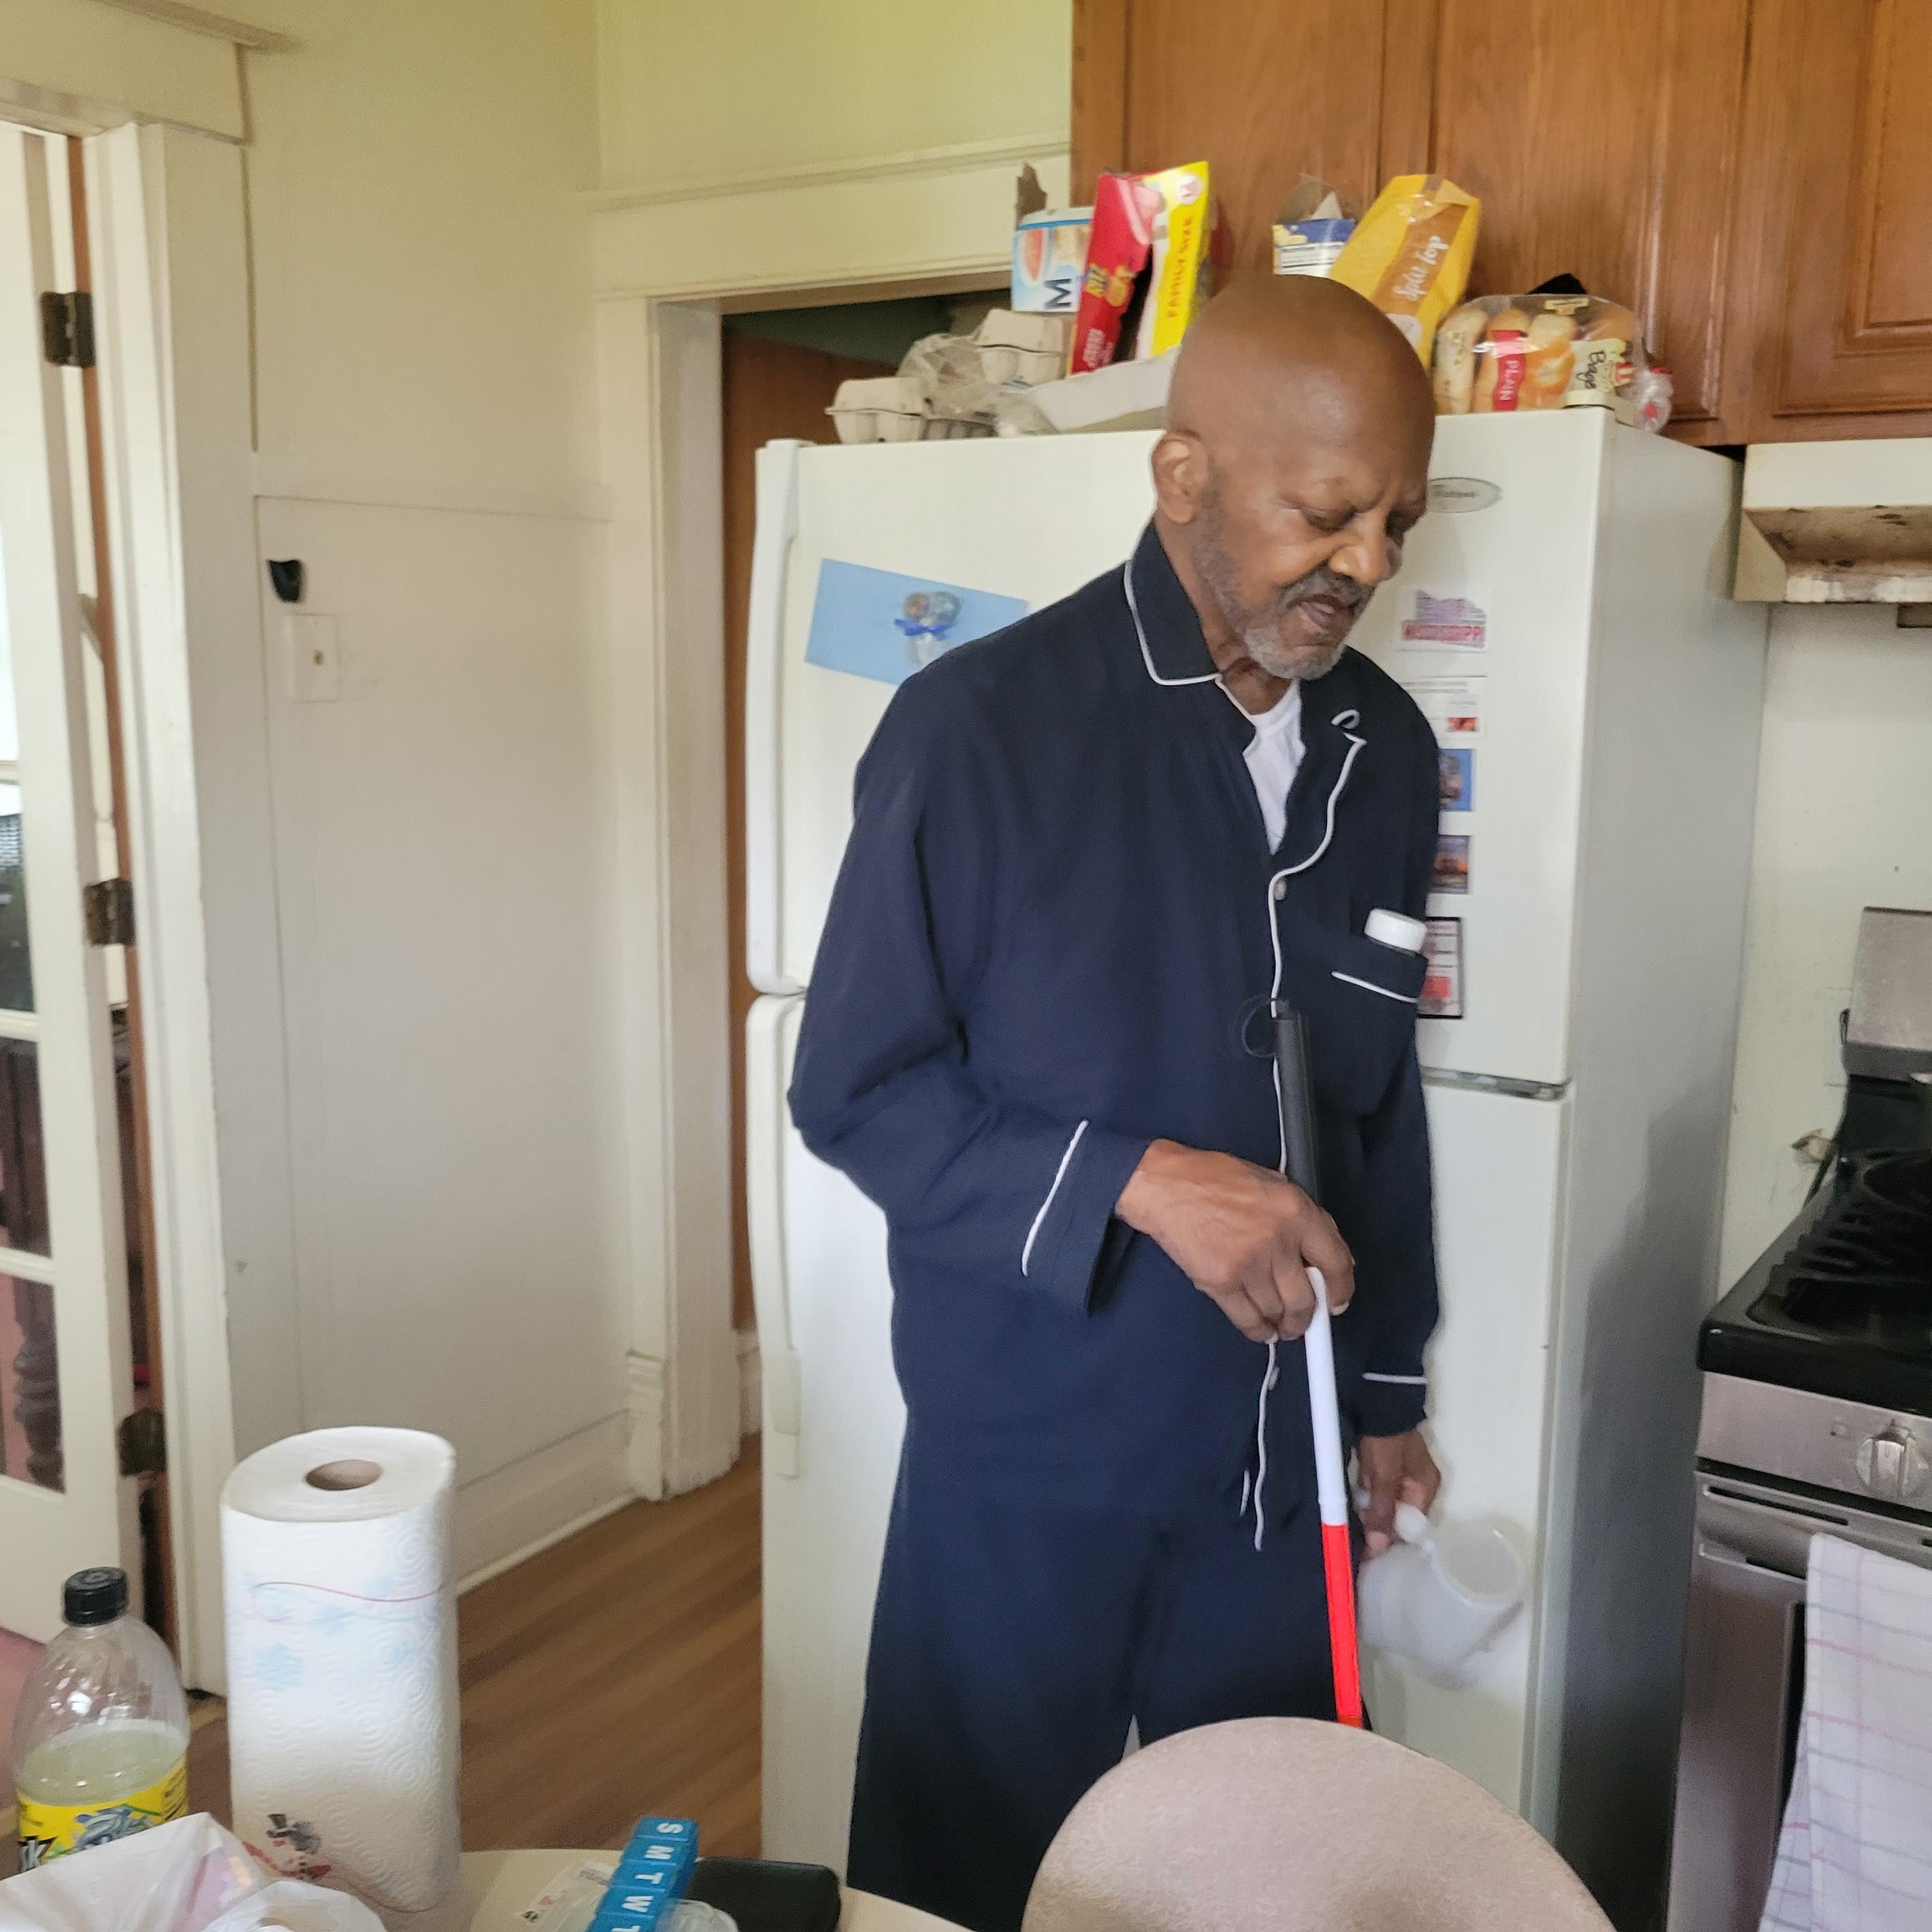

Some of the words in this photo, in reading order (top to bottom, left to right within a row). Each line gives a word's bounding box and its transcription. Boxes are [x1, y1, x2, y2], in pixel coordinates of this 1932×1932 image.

[1044, 278, 1072, 308] M
[1499, 360, 1519, 401] PLAIN
[656, 1823, 684, 1834] S
[643, 1845, 675, 1860] M
[634, 1872, 664, 1884] T
[621, 1896, 654, 1913] W
